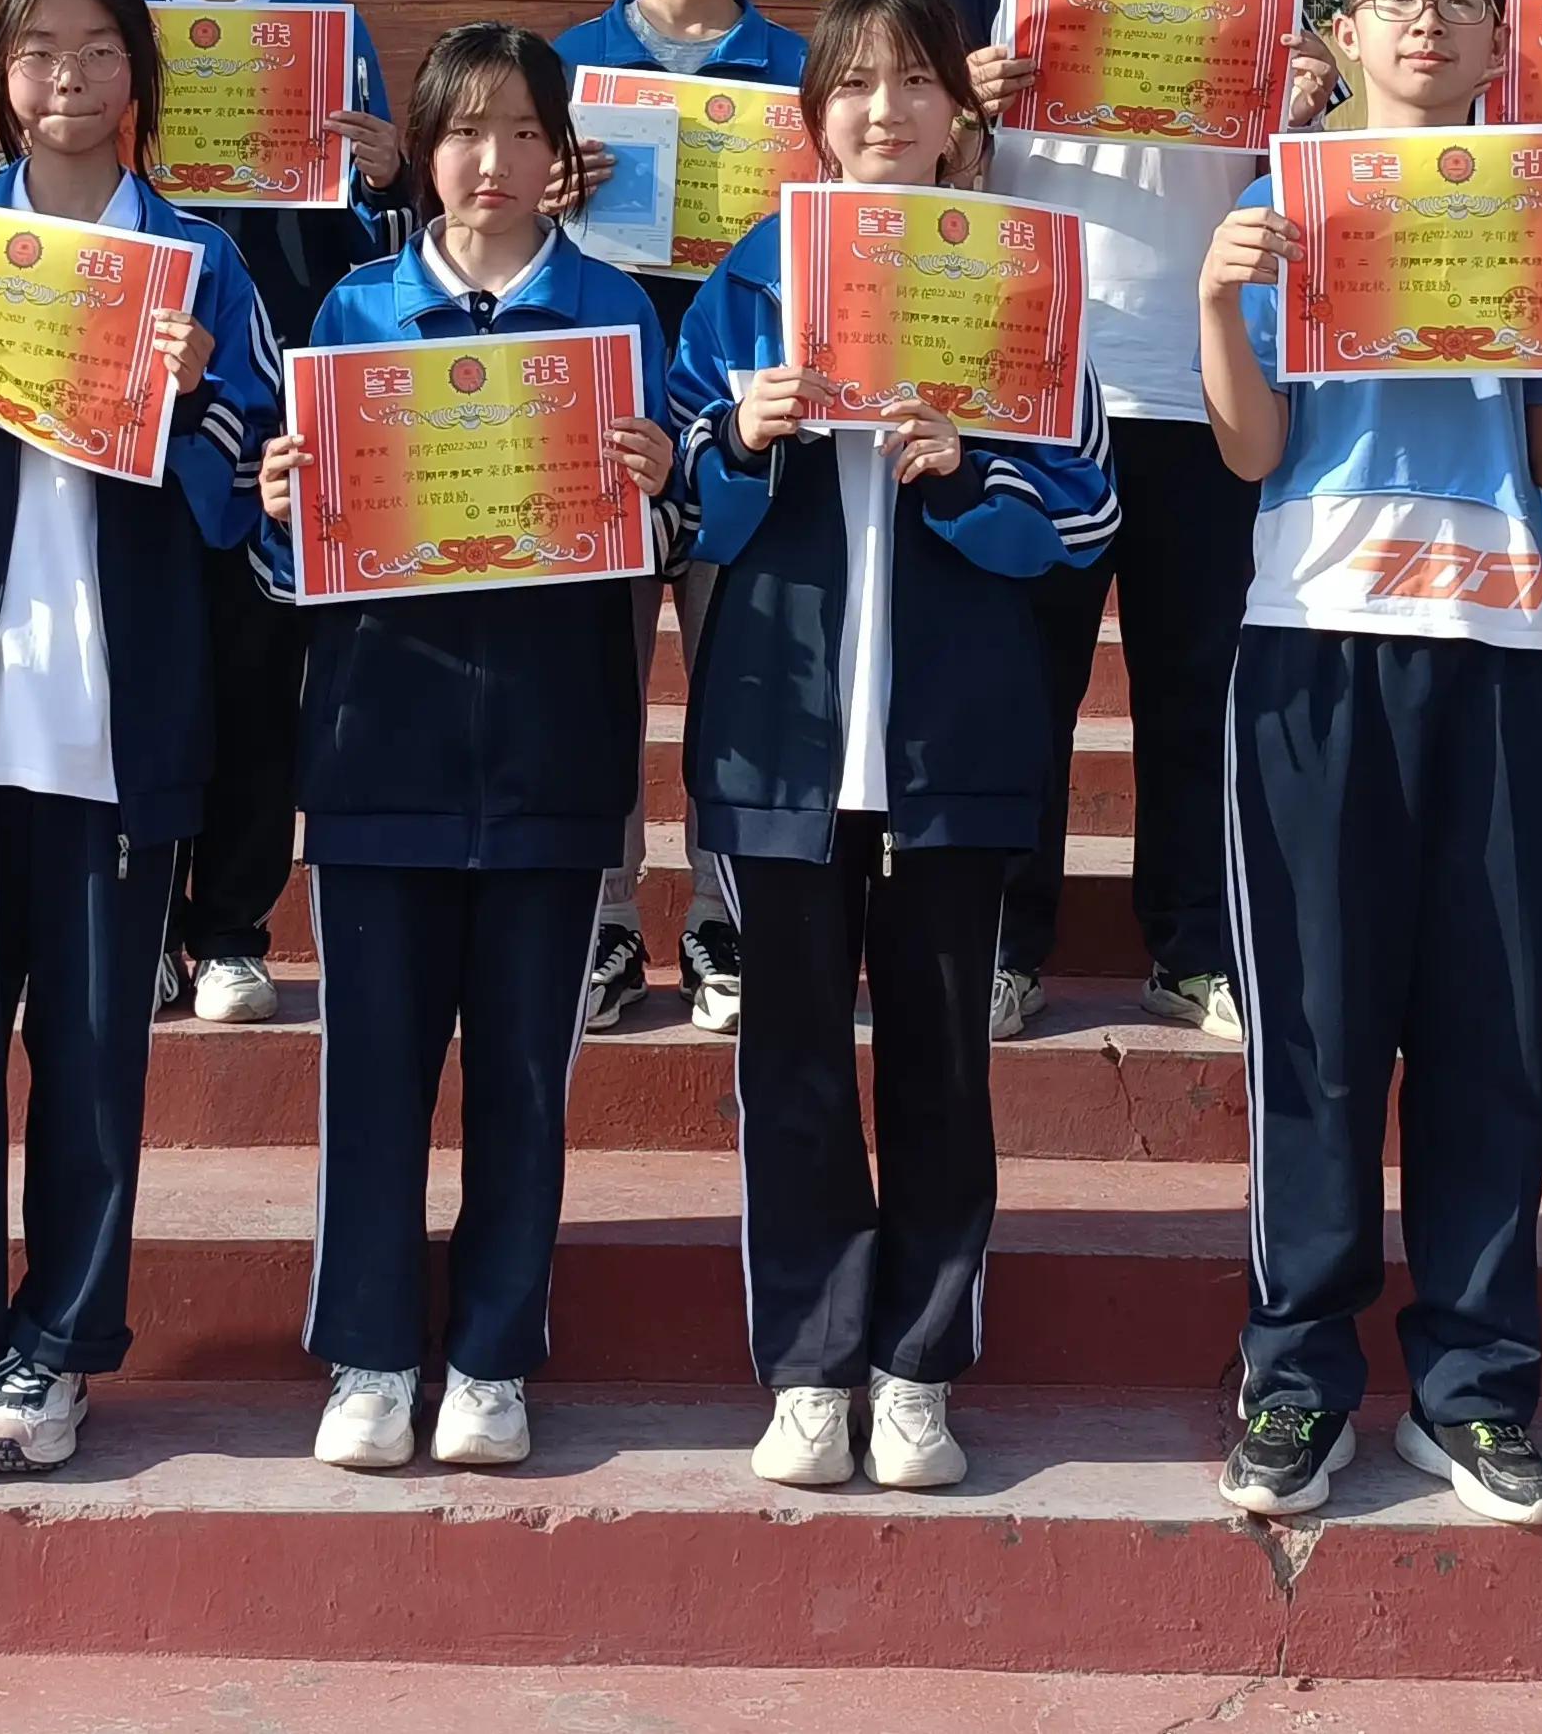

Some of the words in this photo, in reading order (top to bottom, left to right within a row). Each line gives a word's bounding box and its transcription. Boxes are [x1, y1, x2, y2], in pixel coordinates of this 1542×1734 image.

[251, 22, 291, 48] 状
[763, 104, 803, 131] 状
[1352, 152, 1403, 183] 奖
[857, 207, 905, 238] 奖
[998, 219, 1035, 251] 状
[75, 249, 124, 284] 状
[363, 366, 413, 399] 奖
[522, 355, 570, 386] 状
